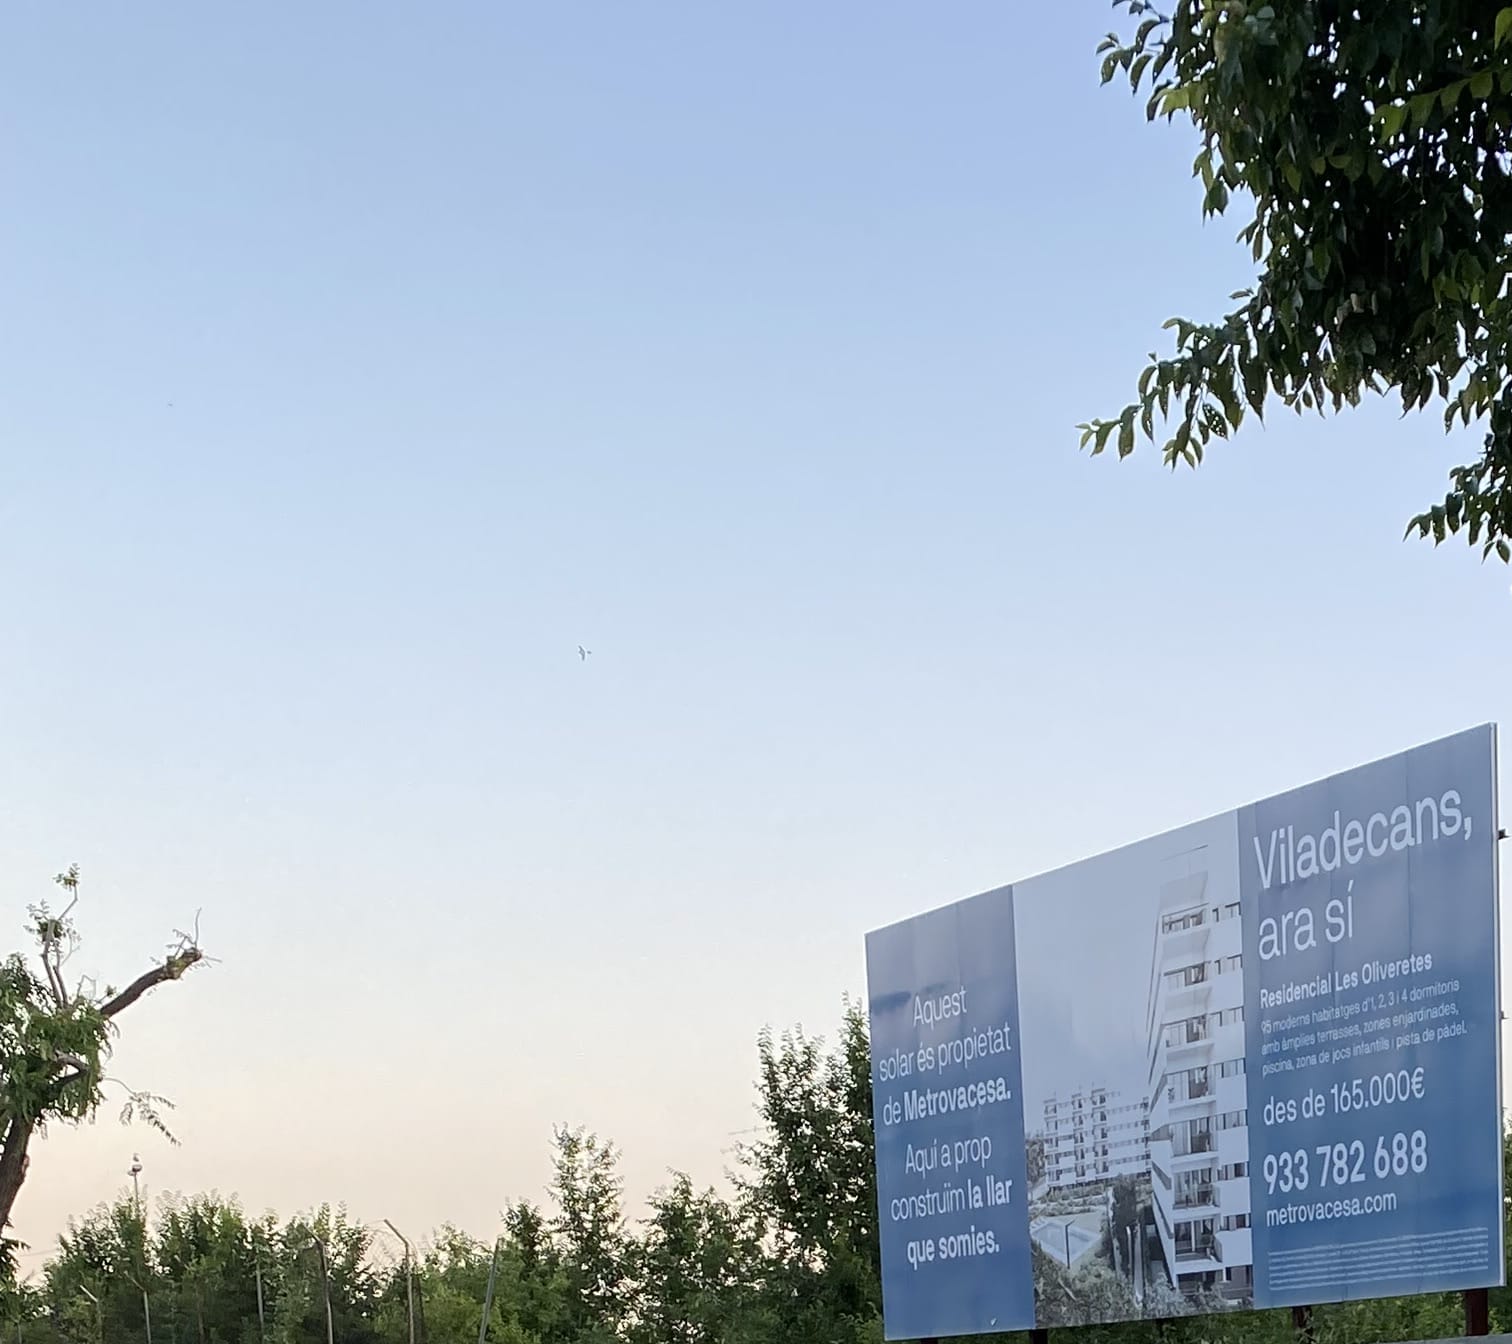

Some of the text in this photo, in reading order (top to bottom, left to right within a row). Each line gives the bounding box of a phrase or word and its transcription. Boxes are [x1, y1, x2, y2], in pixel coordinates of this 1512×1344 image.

[1253, 789, 1472, 889] Viladecans,
[1258, 879, 1354, 960] ara sí
[1260, 953, 1433, 1009] Residencial Les Oliveretes
[1409, 978, 1460, 1003] dormitoris
[913, 985, 968, 1030] Aquest
[879, 1021, 1011, 1082] solar és propietat
[1261, 1039, 1281, 1056] amb
[1363, 1017, 1391, 1034] zones
[1296, 1053, 1317, 1069] zona
[1318, 1049, 1330, 1064] de
[1332, 1045, 1351, 1064] jocs
[1396, 1031, 1420, 1051] pista
[1422, 1027, 1435, 1043] de
[882, 1077, 1012, 1126] de Metrovacesa.
[1263, 1066, 1425, 1126] des de 165.000€
[905, 1135, 992, 1179] Aquí a prop
[1263, 1129, 1428, 1195] 933 782 688
[890, 1174, 1013, 1221] construïm la llar
[1266, 1191, 1398, 1228] metrovacesa.com
[907, 1224, 1000, 1271] que somies.
